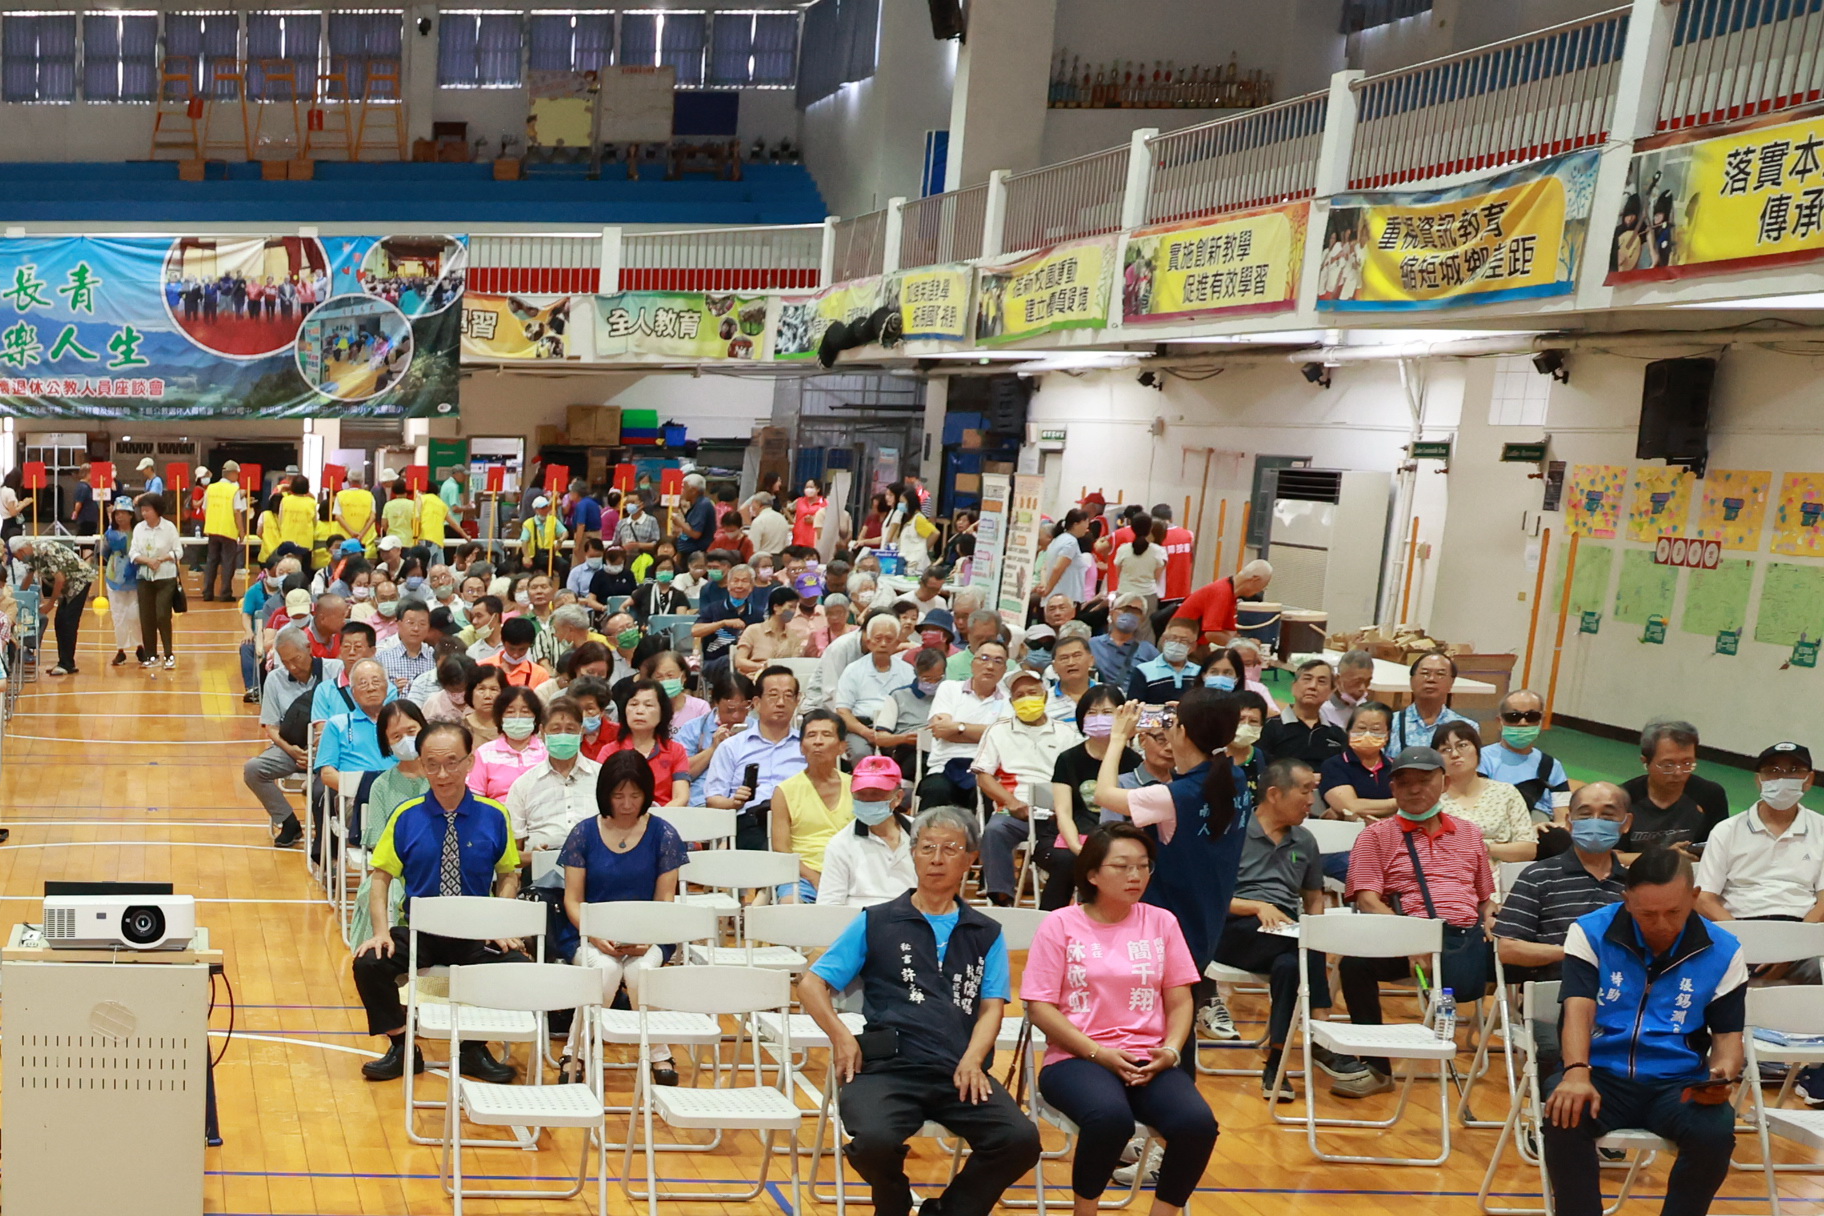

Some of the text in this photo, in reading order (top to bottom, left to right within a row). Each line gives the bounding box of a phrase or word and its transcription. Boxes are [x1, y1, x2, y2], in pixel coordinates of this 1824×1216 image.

[1378, 201, 1509, 250] 重視資訊教育
[1167, 230, 1253, 272] 實施創新教學
[1399, 235, 1538, 290] 縮短城鄉差距
[1182, 264, 1270, 304] 促進有效學習
[608, 308, 702, 338] 全人教育
